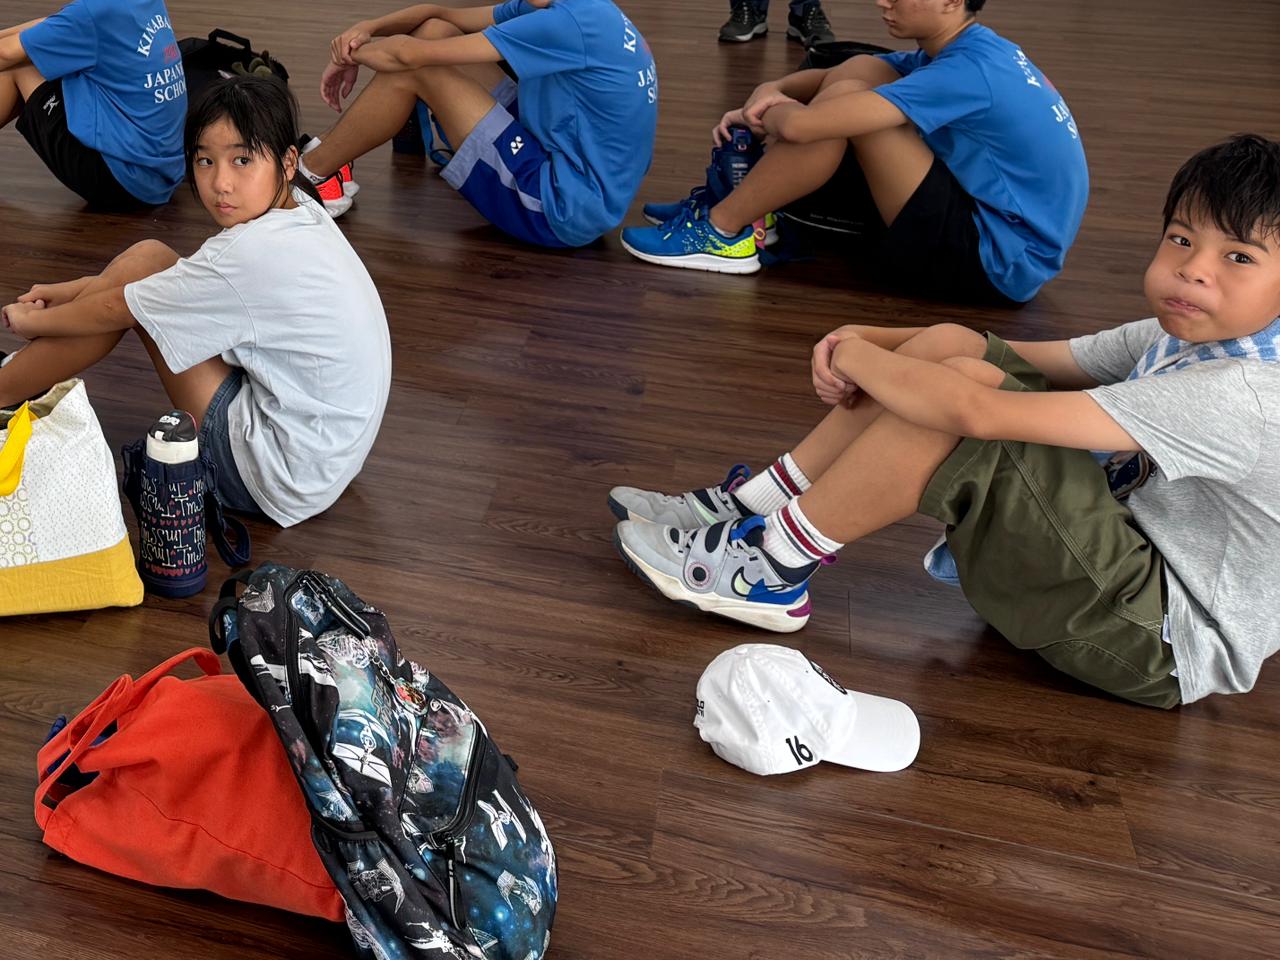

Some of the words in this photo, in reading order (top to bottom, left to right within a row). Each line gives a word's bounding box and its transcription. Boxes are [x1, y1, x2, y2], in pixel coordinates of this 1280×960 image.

[137, 14, 172, 58] KINABA
[144, 60, 184, 89] JAPAN
[154, 79, 187, 104] SCHO
[785, 735, 813, 766] 16
